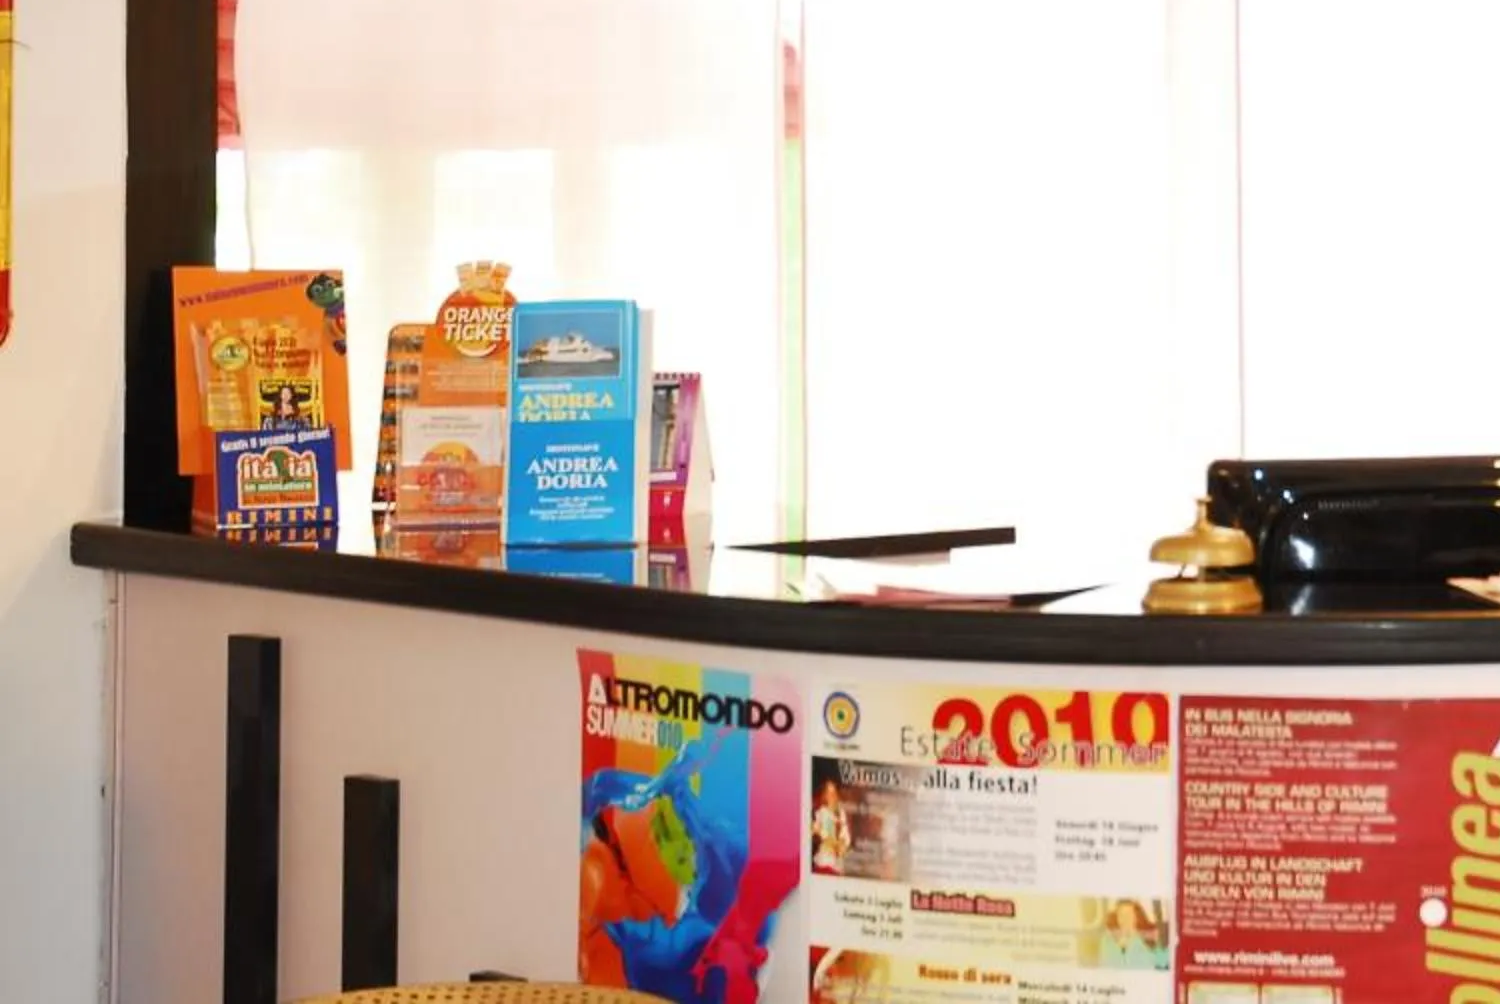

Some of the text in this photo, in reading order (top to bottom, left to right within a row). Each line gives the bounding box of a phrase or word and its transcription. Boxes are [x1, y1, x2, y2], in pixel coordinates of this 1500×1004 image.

[443, 323, 511, 341] TICKET
[519, 391, 615, 409] ANDREA
[526, 456, 620, 475] ANDREA
[536, 473, 609, 490] DORIA
[226, 506, 333, 525] RIMINI
[932, 690, 1171, 769] 2010
[900, 725, 995, 762] Estate
[1017, 731, 1168, 767] Sommer
[923, 767, 962, 792] alla
[967, 770, 1039, 796] fiesta!
